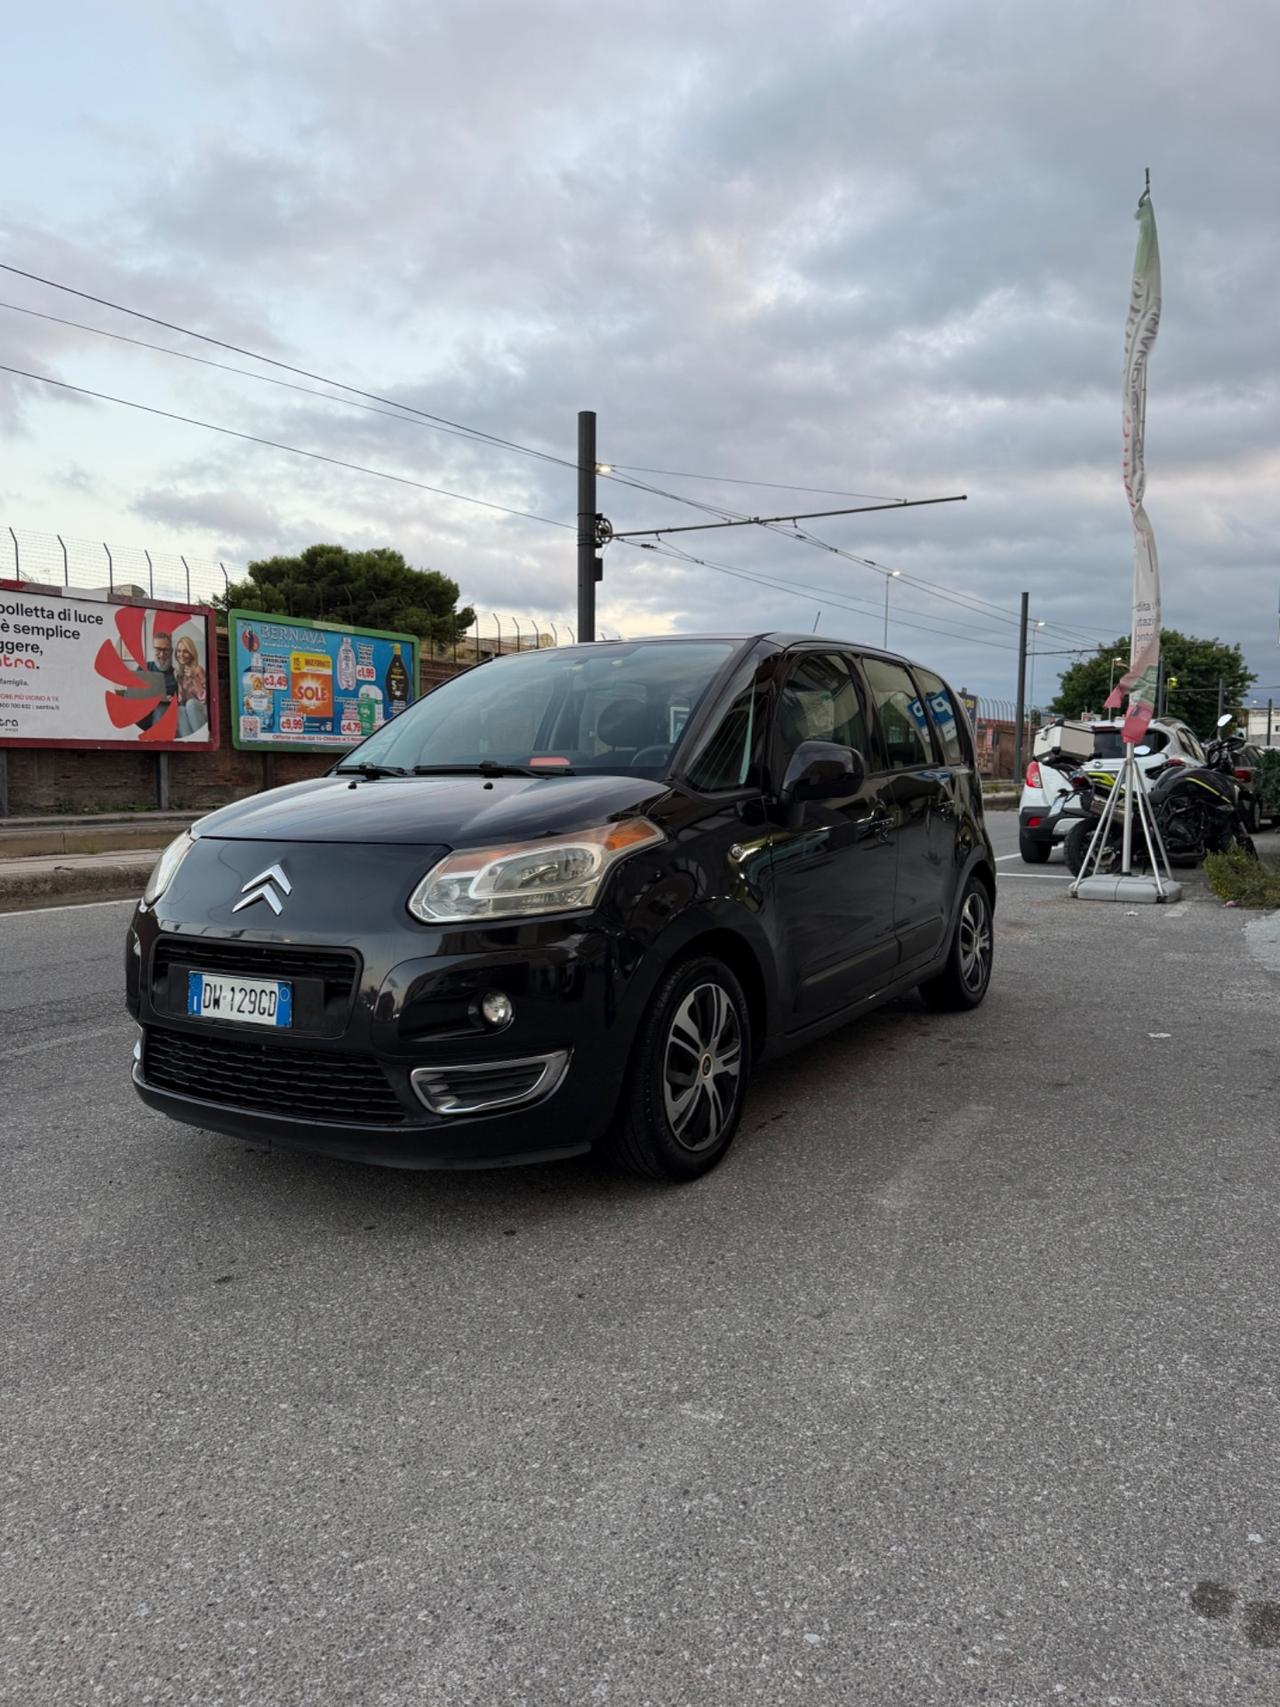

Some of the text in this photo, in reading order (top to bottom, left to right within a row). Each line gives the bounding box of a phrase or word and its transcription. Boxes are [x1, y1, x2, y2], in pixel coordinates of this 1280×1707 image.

[58, 608, 71, 622] di
[74, 609, 104, 625] luce
[1, 618, 80, 640] è semplice
[261, 624, 326, 645] BERNAVA
[297, 685, 327, 702] SOLE
